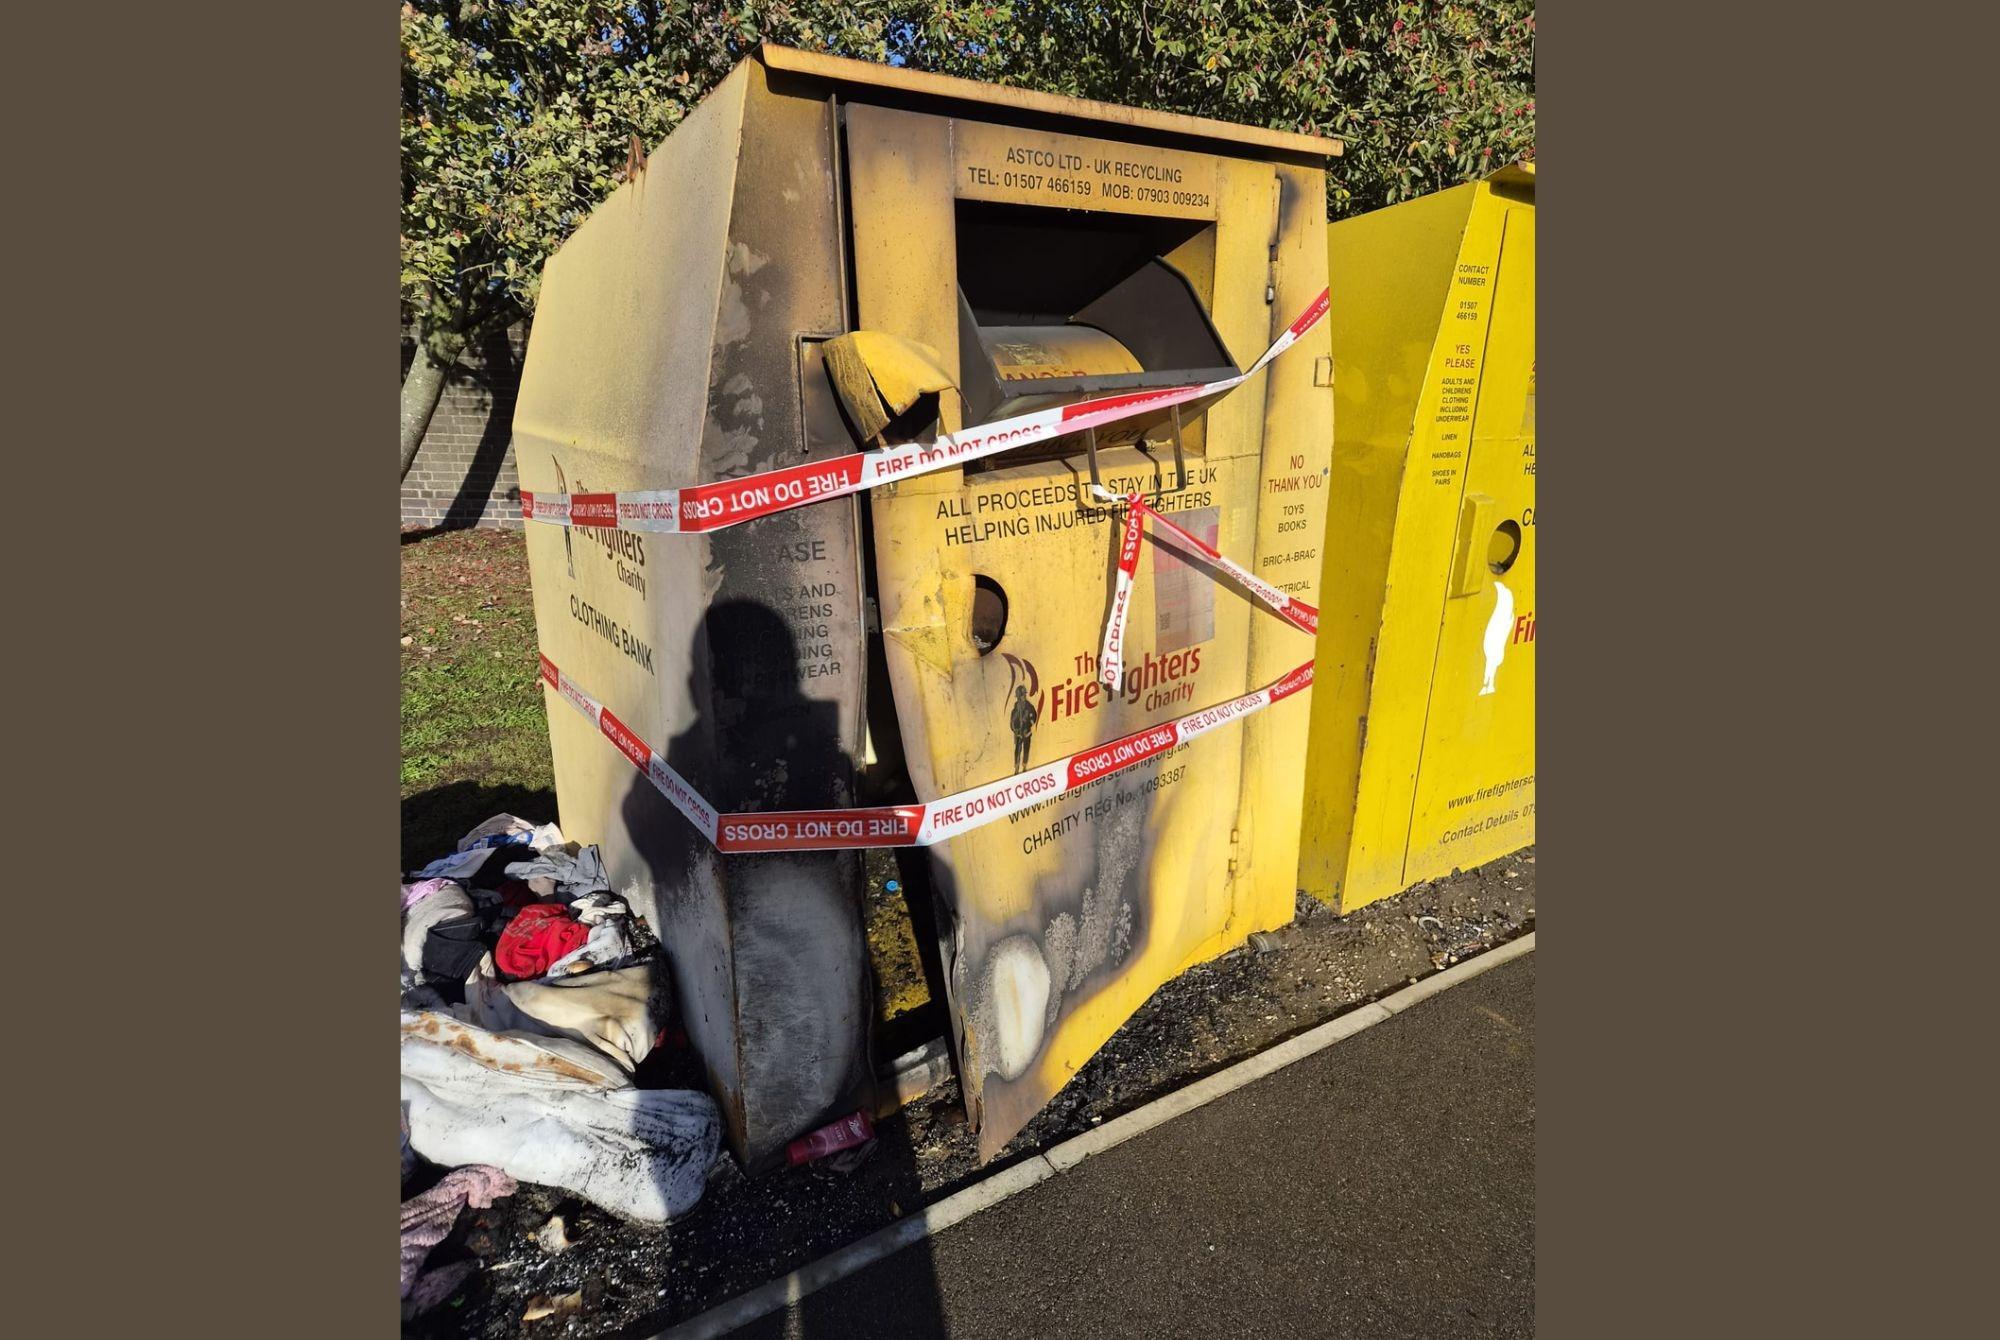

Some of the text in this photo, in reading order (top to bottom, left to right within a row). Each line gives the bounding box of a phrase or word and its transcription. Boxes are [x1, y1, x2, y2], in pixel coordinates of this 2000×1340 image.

[1006, 147, 1054, 168] ASTCO
[1058, 155, 1083, 171] LTD
[1094, 158, 1112, 175] UK
[1115, 161, 1182, 184] RECYCLING
[968, 167, 1210, 208] TEL: 01507 466159 MOB: 07903 009234
[1459, 264, 1489, 275] CONTACT
[1459, 277, 1486, 287] NUMBER
[1460, 301, 1478, 310] 01507
[1456, 344, 1470, 354] YES
[1445, 358, 1476, 369] PLEASE
[1441, 378, 1462, 386] ADULTS
[1442, 387, 1472, 395] CHILDRENS
[1439, 405, 1468, 413] INCLUDING
[1442, 396, 1469, 404] CLOTHING
[1435, 415, 1470, 423] UNDERWEAR
[1441, 433, 1457, 441] LINEN
[1290, 455, 1305, 470] NO
[1431, 451, 1462, 460] HANDBAGS
[1431, 469, 1450, 477] SHOES
[1268, 474, 1323, 494] THANK YOU
[683, 470, 850, 519] FIRE DO NOT CROSS
[937, 499, 972, 520] ALL
[977, 484, 1078, 514] PROCEEDS
[1108, 476, 1144, 495] STAY
[1149, 474, 1163, 490] IN
[1168, 470, 1195, 488] TE
[1199, 467, 1218, 484] UK
[1283, 504, 1305, 516] TOYS
[945, 517, 1030, 546] HELPING
[1035, 507, 1107, 531] INJURED
[1278, 519, 1307, 533] BOOKS
[1263, 549, 1316, 567] BRIC-A-BRAC
[616, 559, 646, 600] Charity
[800, 583, 836, 598] AND
[570, 594, 655, 676] CLOTHING BANK
[1104, 657, 1118, 682] OT
[1051, 679, 1100, 723] Fire
[1182, 717, 1204, 734] FIRE
[1202, 711, 1218, 726] DO
[1216, 704, 1235, 720] NOT
[1073, 728, 1173, 778] FIRE DO NOT CROSS
[933, 773, 1056, 829] FIRE DO NOT CROSS
[1448, 775, 1536, 810] www.firefightersc
[1023, 811, 1081, 855] CHARITY
[1085, 801, 1113, 822] REG
[1139, 765, 1186, 798] 1093387
[724, 818, 909, 841] FIRE DO NOT CROSS
[1442, 822, 1484, 845] Contact
[1486, 809, 1519, 830] Details
